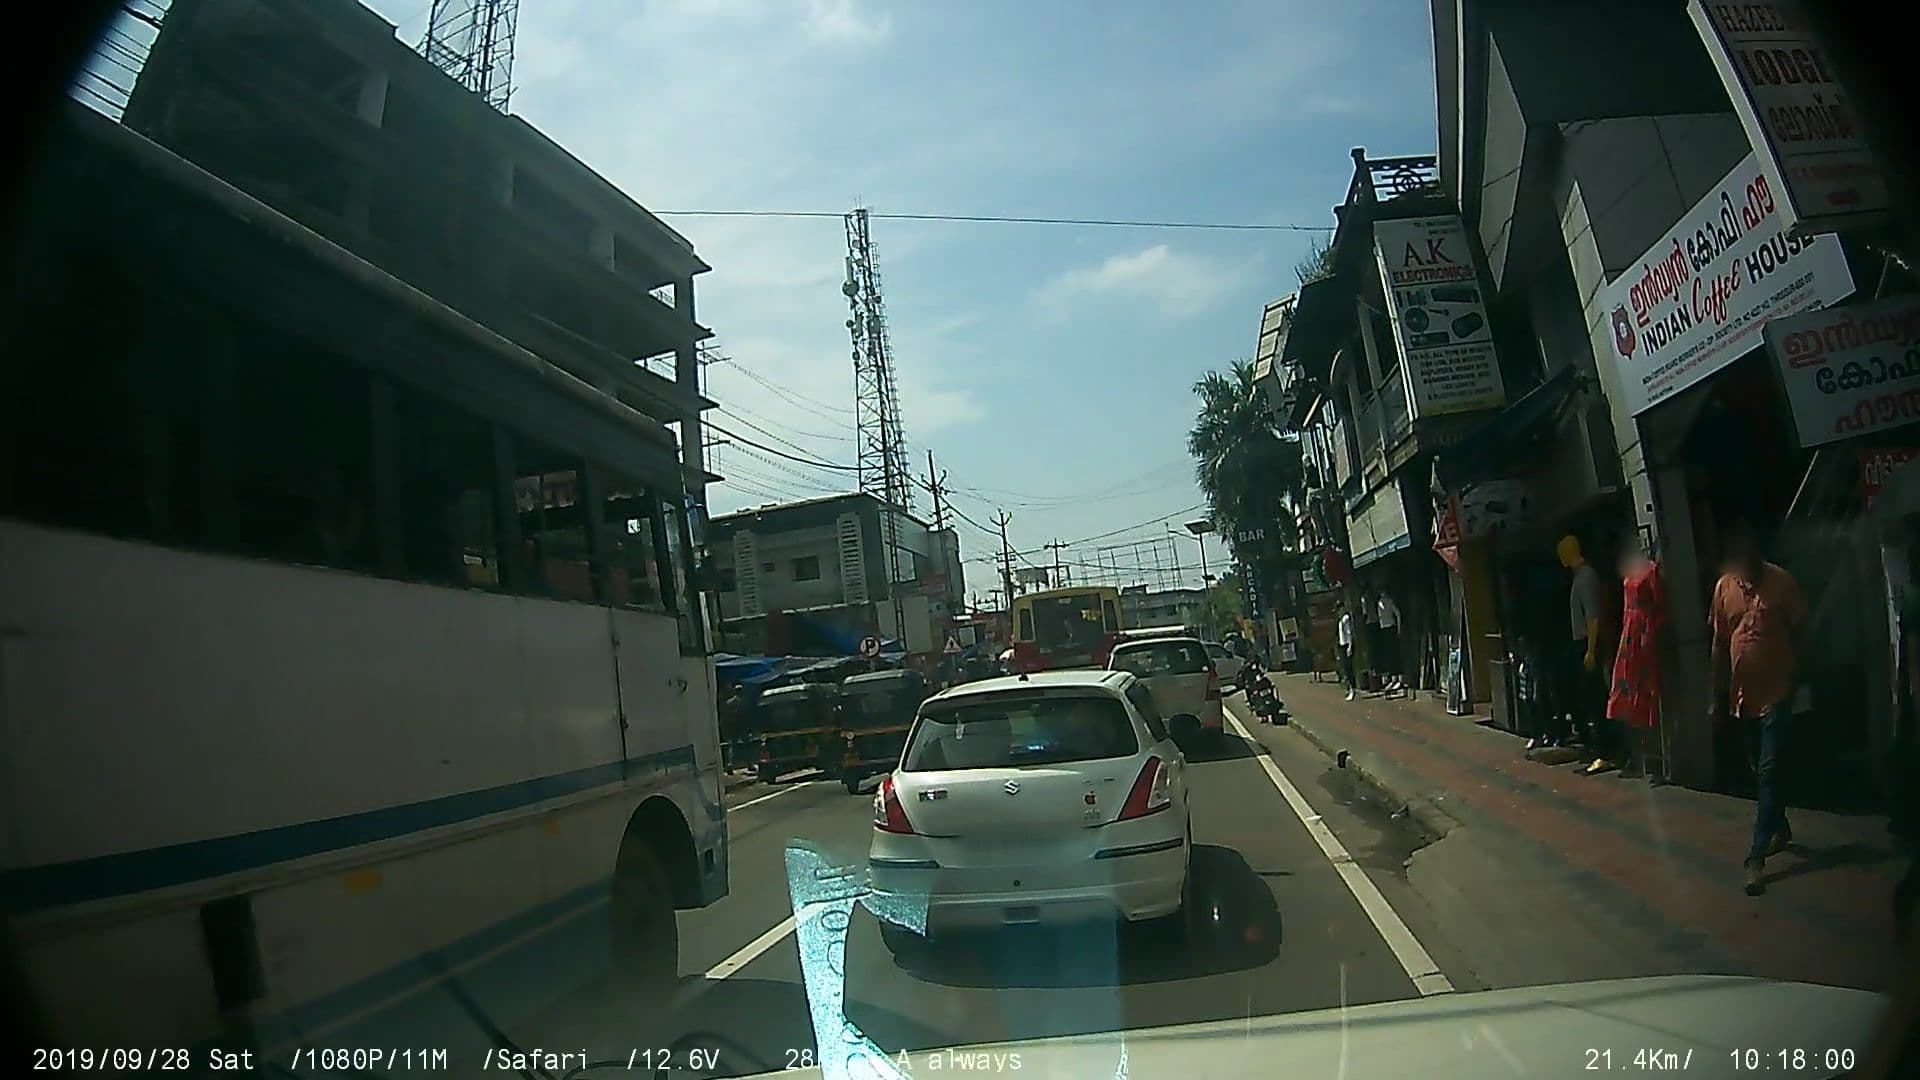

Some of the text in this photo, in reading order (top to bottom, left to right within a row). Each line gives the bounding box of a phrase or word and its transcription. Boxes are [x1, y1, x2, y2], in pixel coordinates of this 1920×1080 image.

[1686, 191, 1743, 273] കോഫി
[1392, 265, 1474, 284] ELECTRONICS
[1641, 304, 1692, 357] INDIAN
[1238, 528, 1265, 543] BAR
[1246, 563, 1259, 617] ARCADIA
